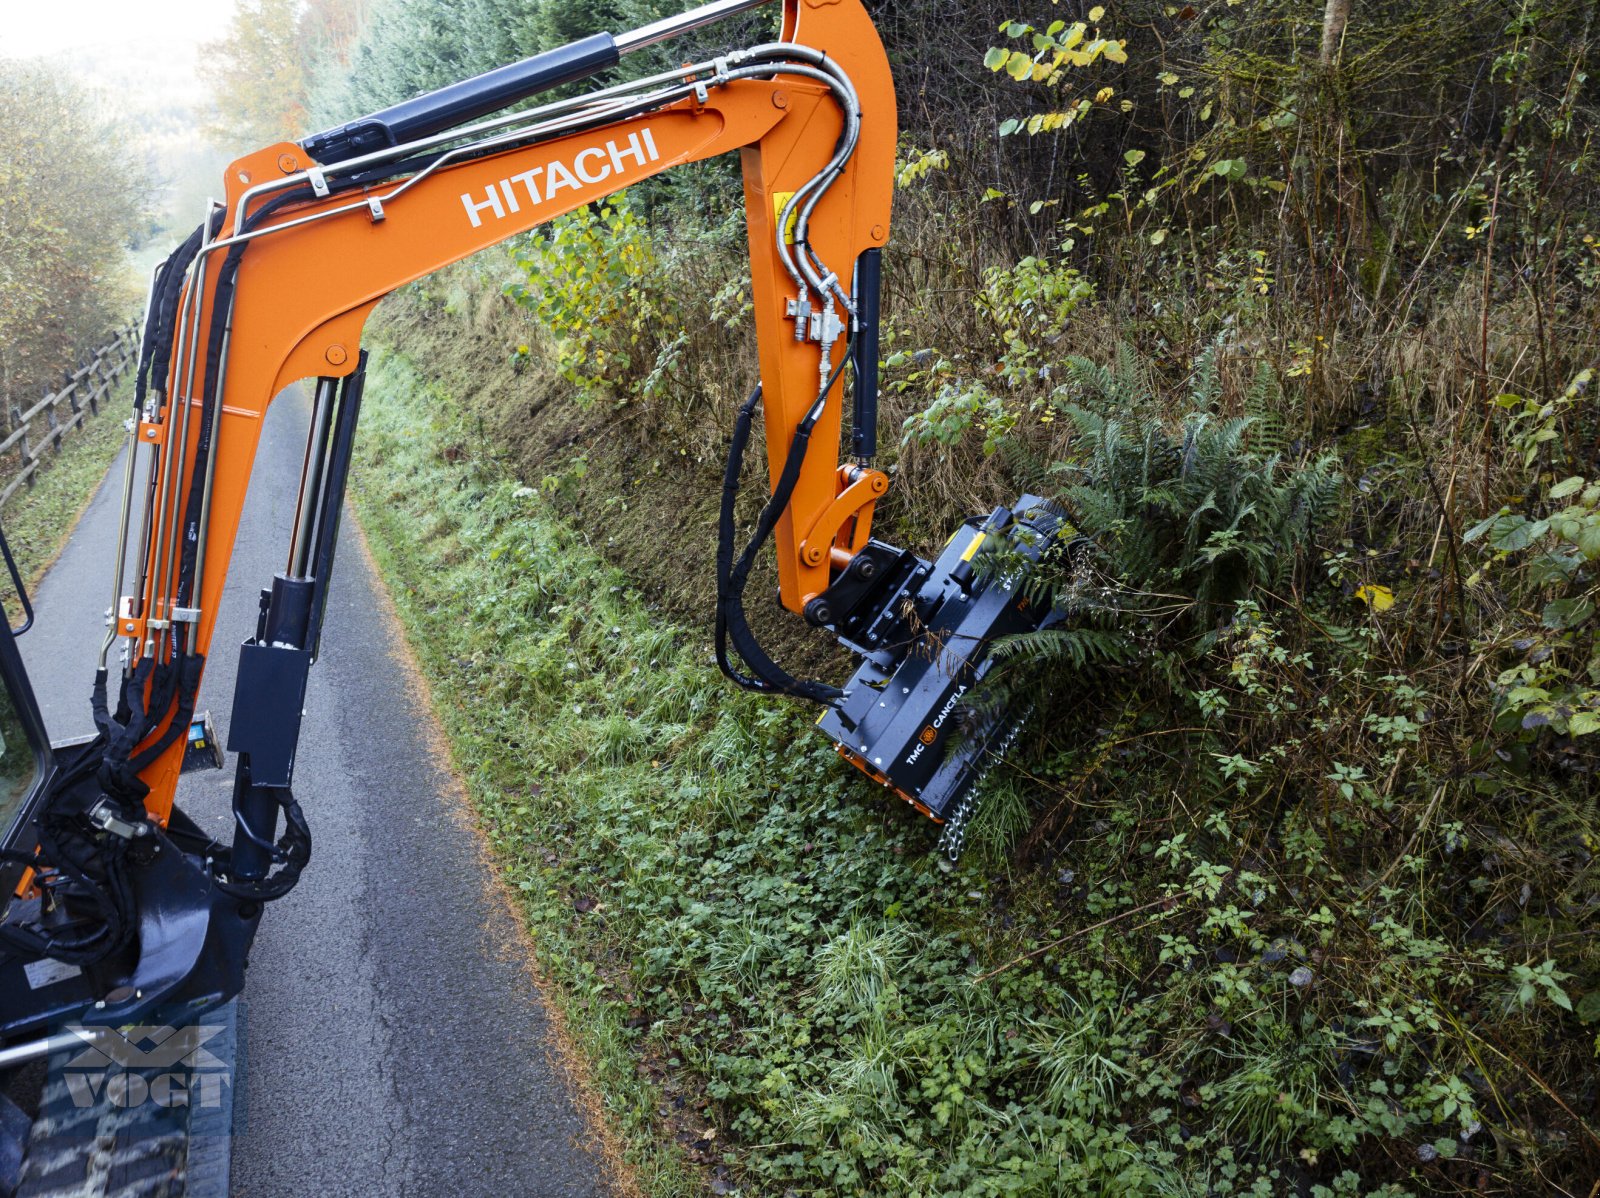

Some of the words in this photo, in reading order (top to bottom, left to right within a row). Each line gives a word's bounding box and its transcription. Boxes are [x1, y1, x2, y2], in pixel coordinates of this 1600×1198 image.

[460, 128, 659, 228] HITACHI
[906, 743, 925, 765] TMC
[933, 685, 967, 728] CANCELA
